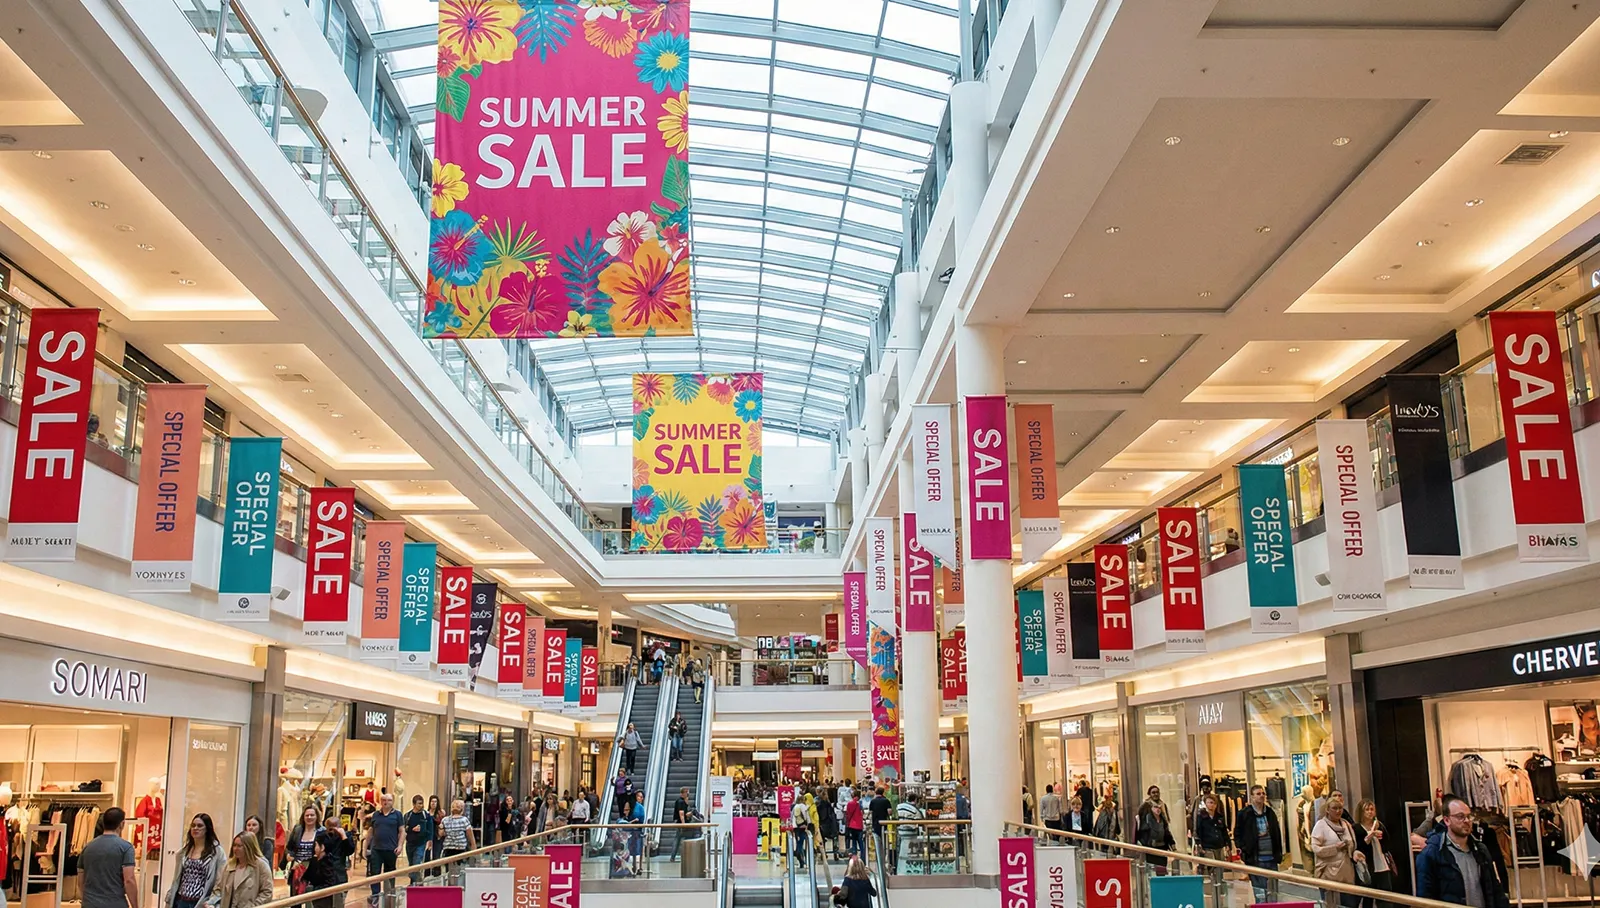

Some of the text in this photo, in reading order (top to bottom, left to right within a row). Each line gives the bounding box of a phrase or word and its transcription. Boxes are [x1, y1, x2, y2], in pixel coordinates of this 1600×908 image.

[479, 96, 647, 128] SUMMER
[475, 133, 647, 190] SALE
[25, 330, 86, 480] SALE
[654, 422, 742, 441] SUMMER
[1504, 333, 1567, 481] SALE
[154, 411, 184, 533] SPECIAL OFFER
[653, 444, 742, 475] SALE
[925, 420, 941, 502] SPECIAL OFFER
[972, 428, 1004, 521] SALE
[1027, 420, 1045, 501] SPECIAL OFFER
[231, 482, 252, 546] OFFER
[249, 471, 271, 556] SPECIAL
[1335, 444, 1363, 557] SPECIAL OFFER
[312, 500, 347, 595] SALE
[873, 529, 886, 591] SPECIAL OFFER
[1165, 519, 1197, 605] SALE
[1250, 506, 1268, 565] OFFER
[1265, 497, 1285, 573] SPECIAL
[374, 540, 391, 621] SPECIAL OFFER
[404, 574, 417, 618] OFFER
[415, 567, 430, 626] SPECIAL
[908, 537, 930, 606] SALE
[1100, 554, 1127, 629] SALE
[443, 576, 468, 644] SALE
[502, 611, 522, 667] SALE
[1023, 615, 1034, 651] OFFER
[1032, 608, 1044, 655] SPECIAL
[1053, 591, 1067, 654] SPECIAL OFFER
[51, 658, 148, 704] SOMARI
[546, 636, 562, 683] SALE
[582, 655, 595, 696] SALE
[943, 647, 957, 688] SALE
[1512, 641, 1600, 675] CHERVE
[877, 751, 899, 761] SALE
